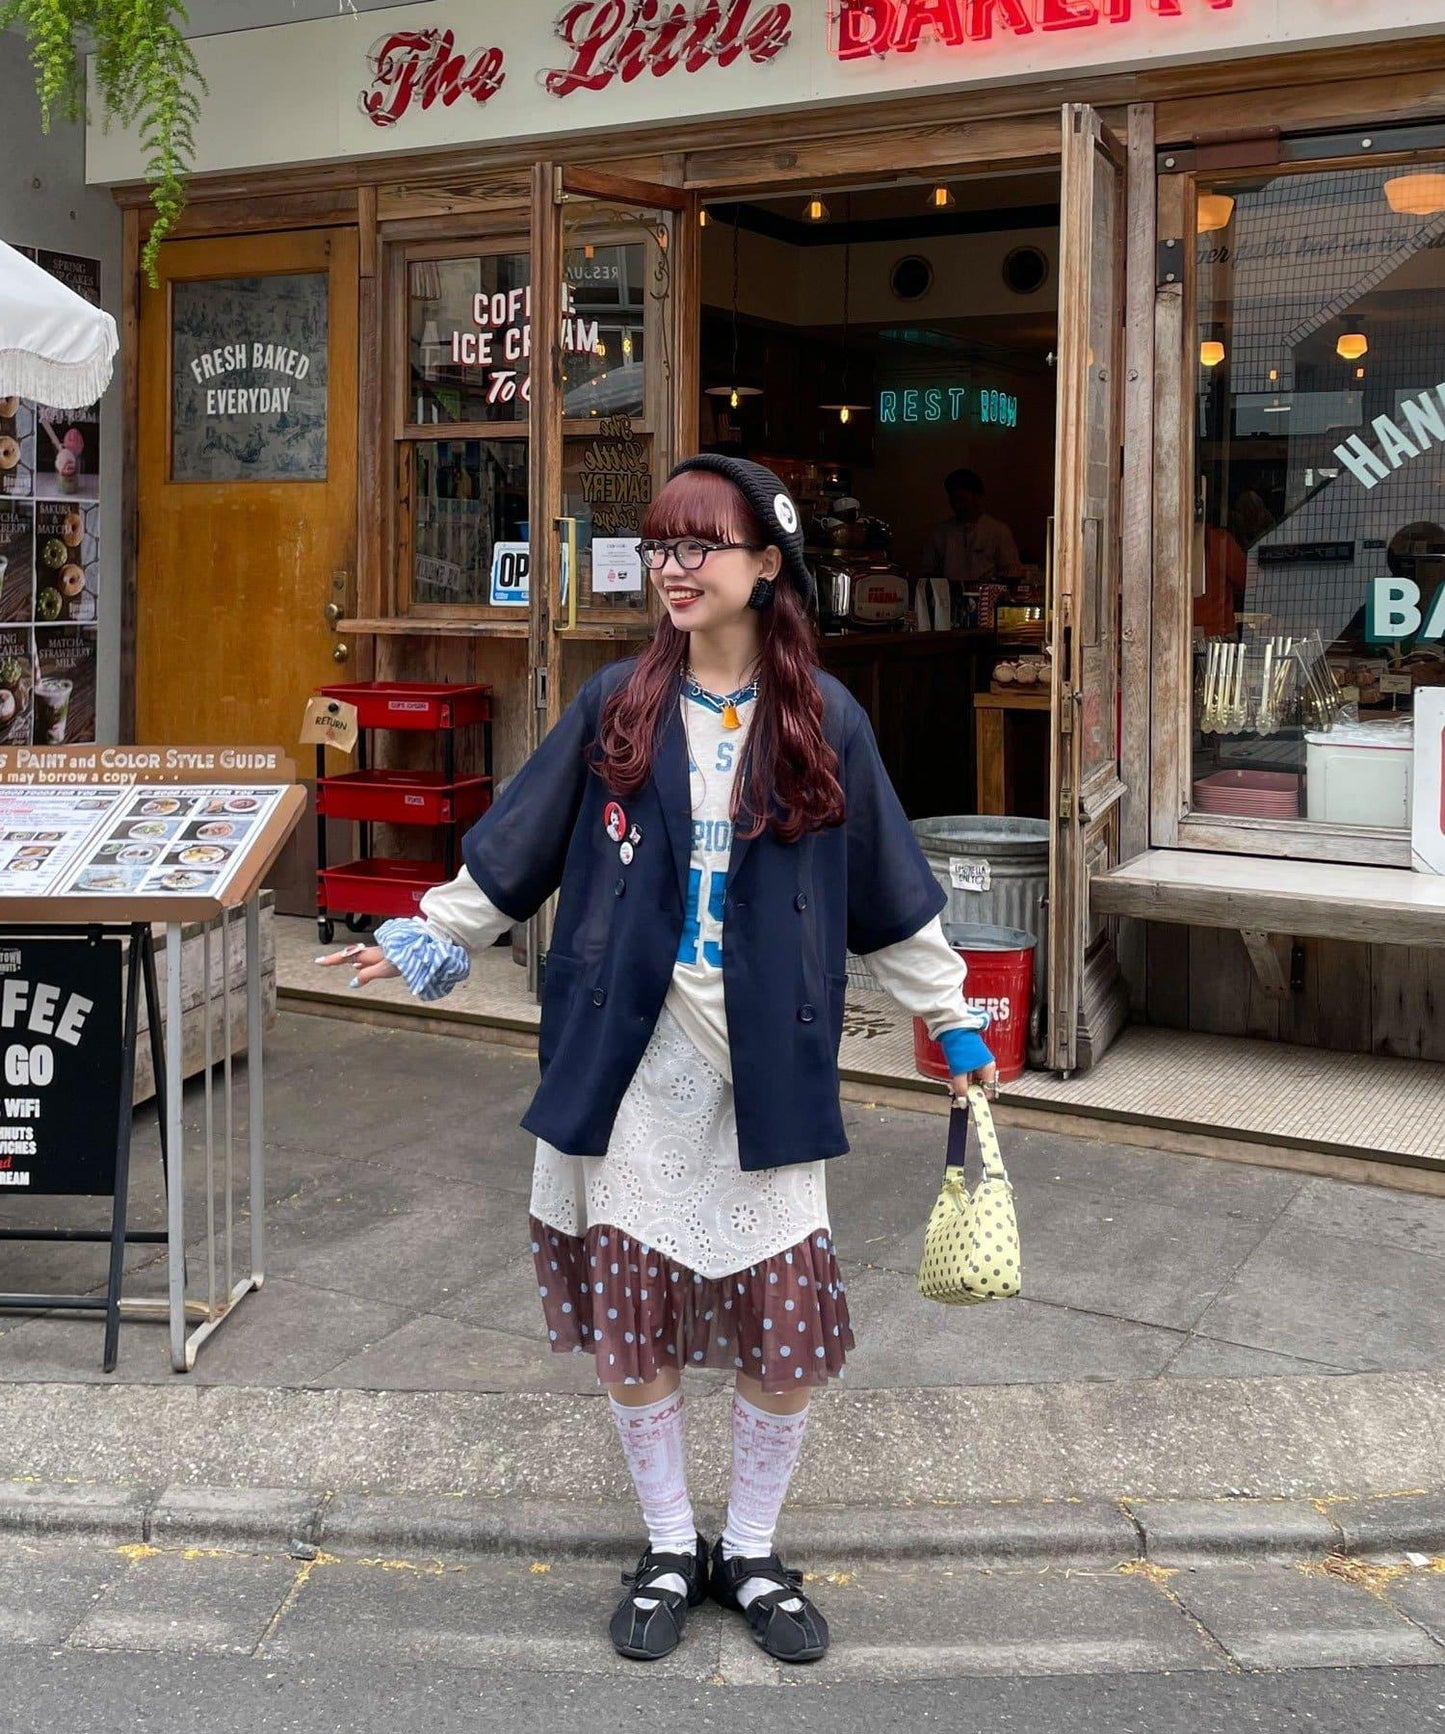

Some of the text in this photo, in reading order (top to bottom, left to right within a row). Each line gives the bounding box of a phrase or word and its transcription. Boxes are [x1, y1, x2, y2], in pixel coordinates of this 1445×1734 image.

[359, 27, 505, 127] The
[540, 0, 793, 98] Little
[474, 282, 576, 326] COFE
[452, 319, 599, 364] ICE CAM
[190, 342, 311, 384] FRESH BAKED
[207, 387, 291, 415] EVERYDAY
[489, 371, 517, 403] To
[880, 388, 1018, 428] REST ROOM
[1333, 382, 1445, 489] HAN
[37, 524, 74, 534] MATCHA
[49, 639, 84, 648] MATCHA
[56, 657, 77, 667] MILK
[315, 716, 347, 730] RETURN
[69, 753, 96, 769] and
[8, 770, 137, 785] may borrow a copy
[691, 820, 734, 853] PIO
[1, 979, 94, 1047] FEE
[4, 1044, 54, 1086] GO
[4, 1098, 40, 1118] WiFi
